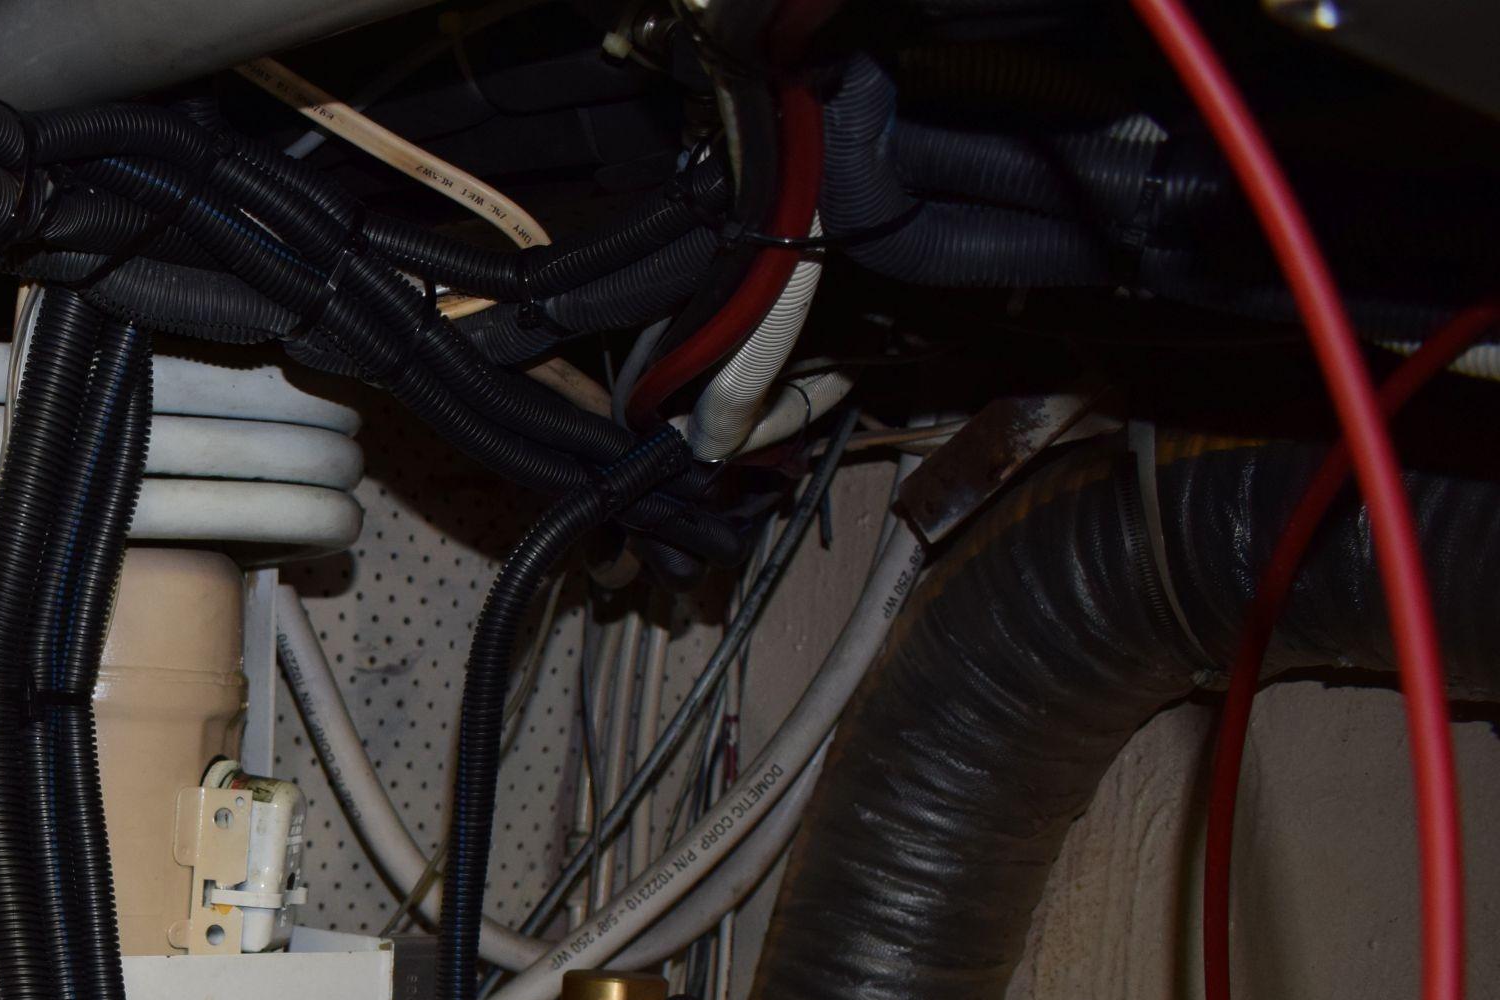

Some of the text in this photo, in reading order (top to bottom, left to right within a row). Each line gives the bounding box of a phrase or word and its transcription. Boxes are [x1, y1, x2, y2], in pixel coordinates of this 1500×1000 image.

[893, 569, 912, 596] 250
[882, 595, 899, 619] WP
[733, 763, 784, 819] DOMETIC
[672, 852, 698, 872] P/N
[625, 869, 675, 912] 1022310
[570, 931, 595, 954] 250
[550, 950, 573, 971] WP
